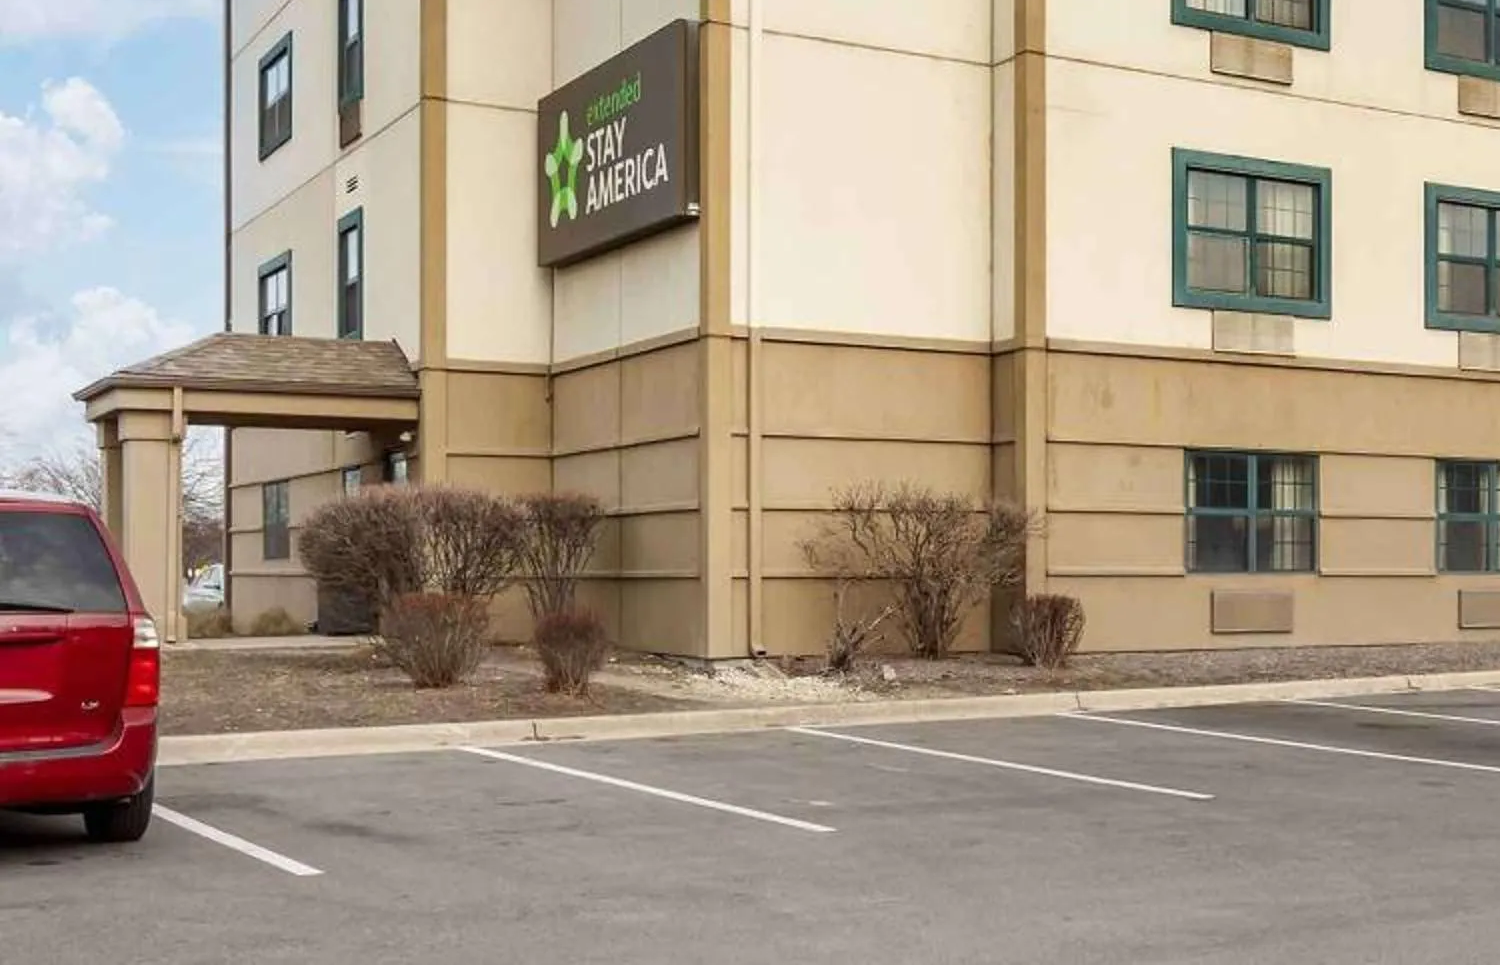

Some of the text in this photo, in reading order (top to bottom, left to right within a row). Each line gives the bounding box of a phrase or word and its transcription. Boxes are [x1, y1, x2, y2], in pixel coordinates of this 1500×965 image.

[586, 71, 641, 125] extended
[586, 116, 627, 172] STAY
[585, 142, 669, 215] AMERICA
